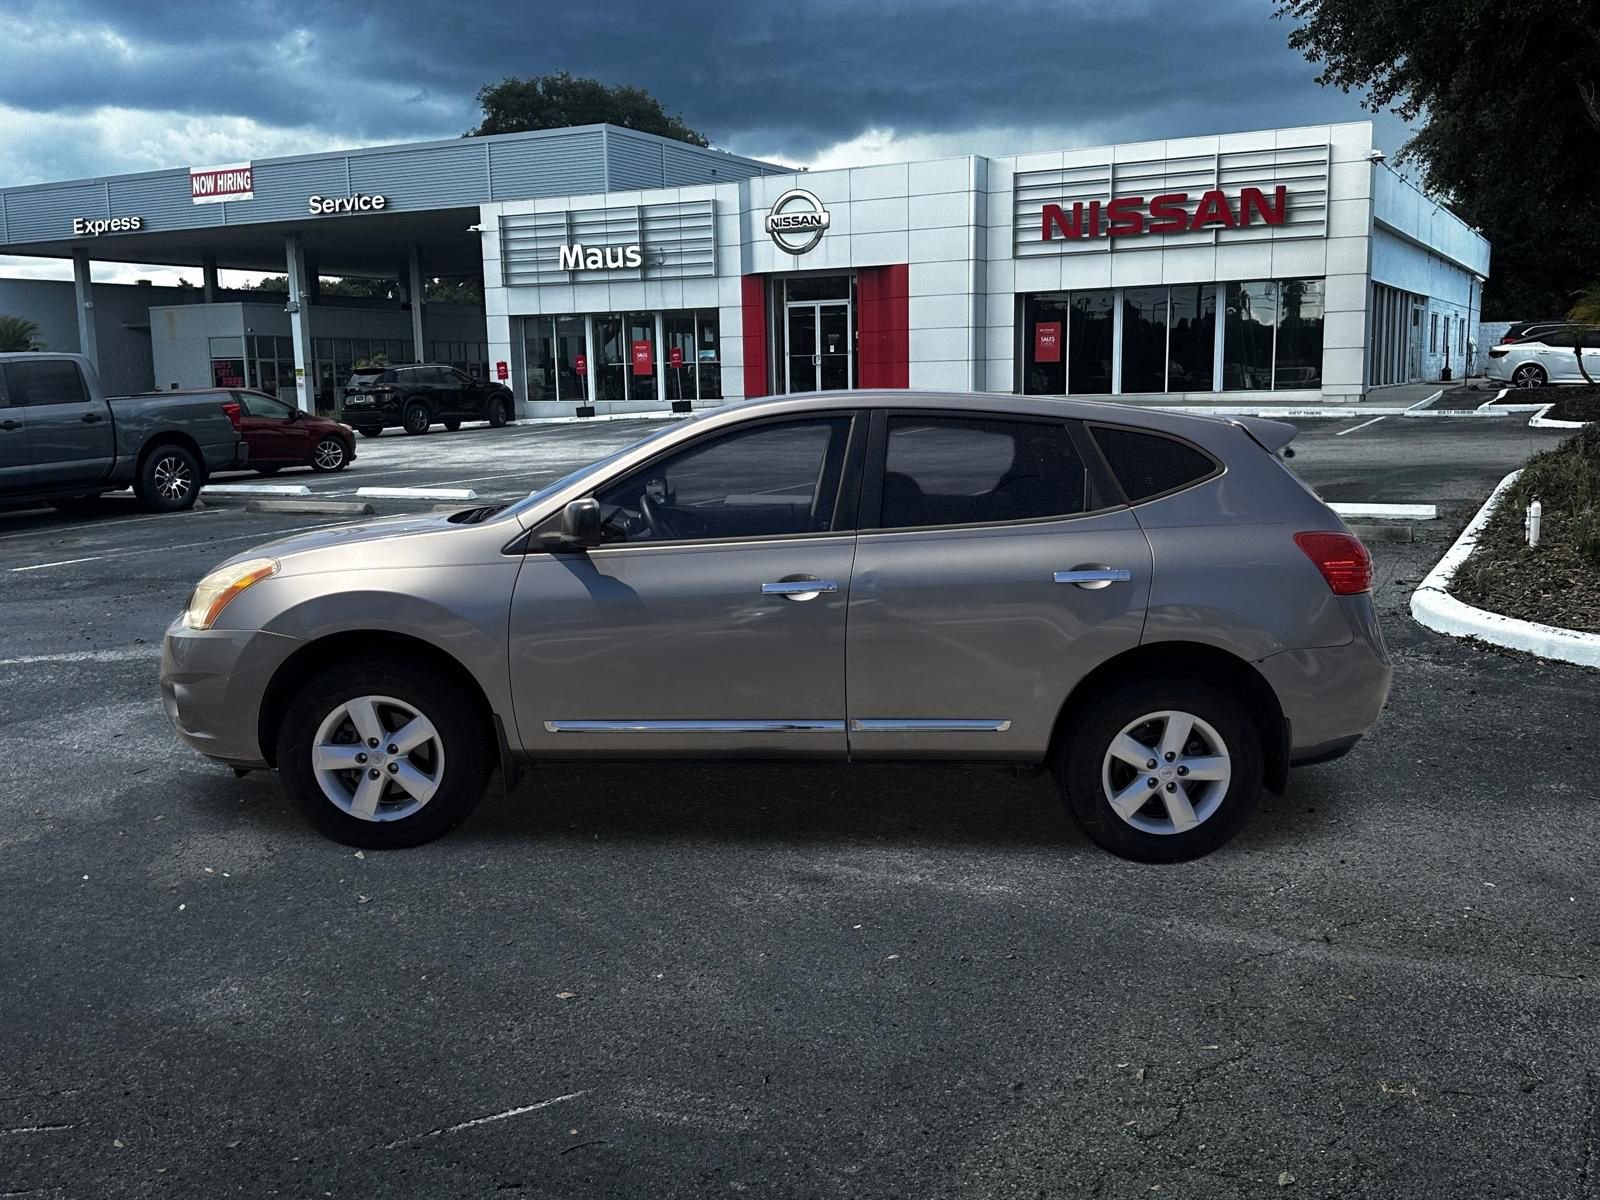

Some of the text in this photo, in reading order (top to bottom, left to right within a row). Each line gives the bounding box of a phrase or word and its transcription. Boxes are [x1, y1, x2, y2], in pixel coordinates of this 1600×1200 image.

[192, 171, 251, 195] NOW HIRING
[308, 193, 385, 214] Service
[1042, 185, 1287, 241] NISSAN
[73, 216, 141, 237] Express
[770, 215, 822, 228] NISSAN
[559, 244, 642, 271] Maus
